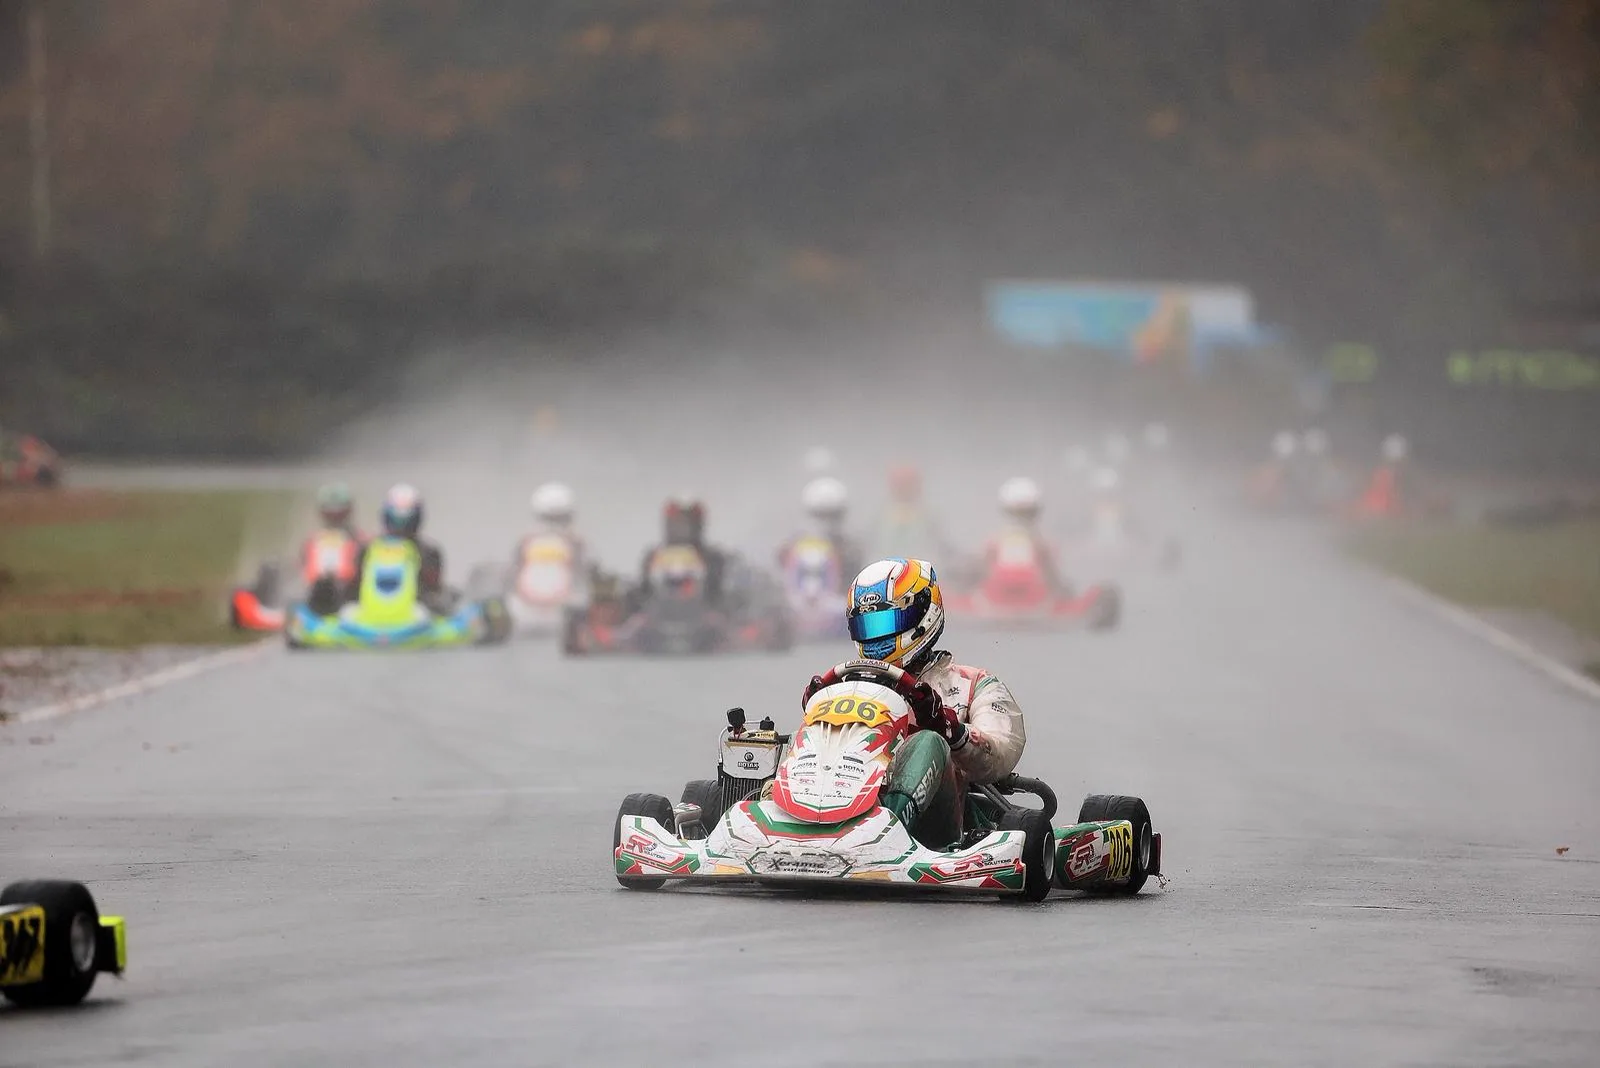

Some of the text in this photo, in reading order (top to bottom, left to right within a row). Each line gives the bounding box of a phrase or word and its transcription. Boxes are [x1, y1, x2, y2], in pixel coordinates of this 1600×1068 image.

[860, 594, 878, 604] Arai
[812, 699, 877, 720] 306
[843, 764, 864, 773] ROTAX
[1107, 827, 1131, 878] 306
